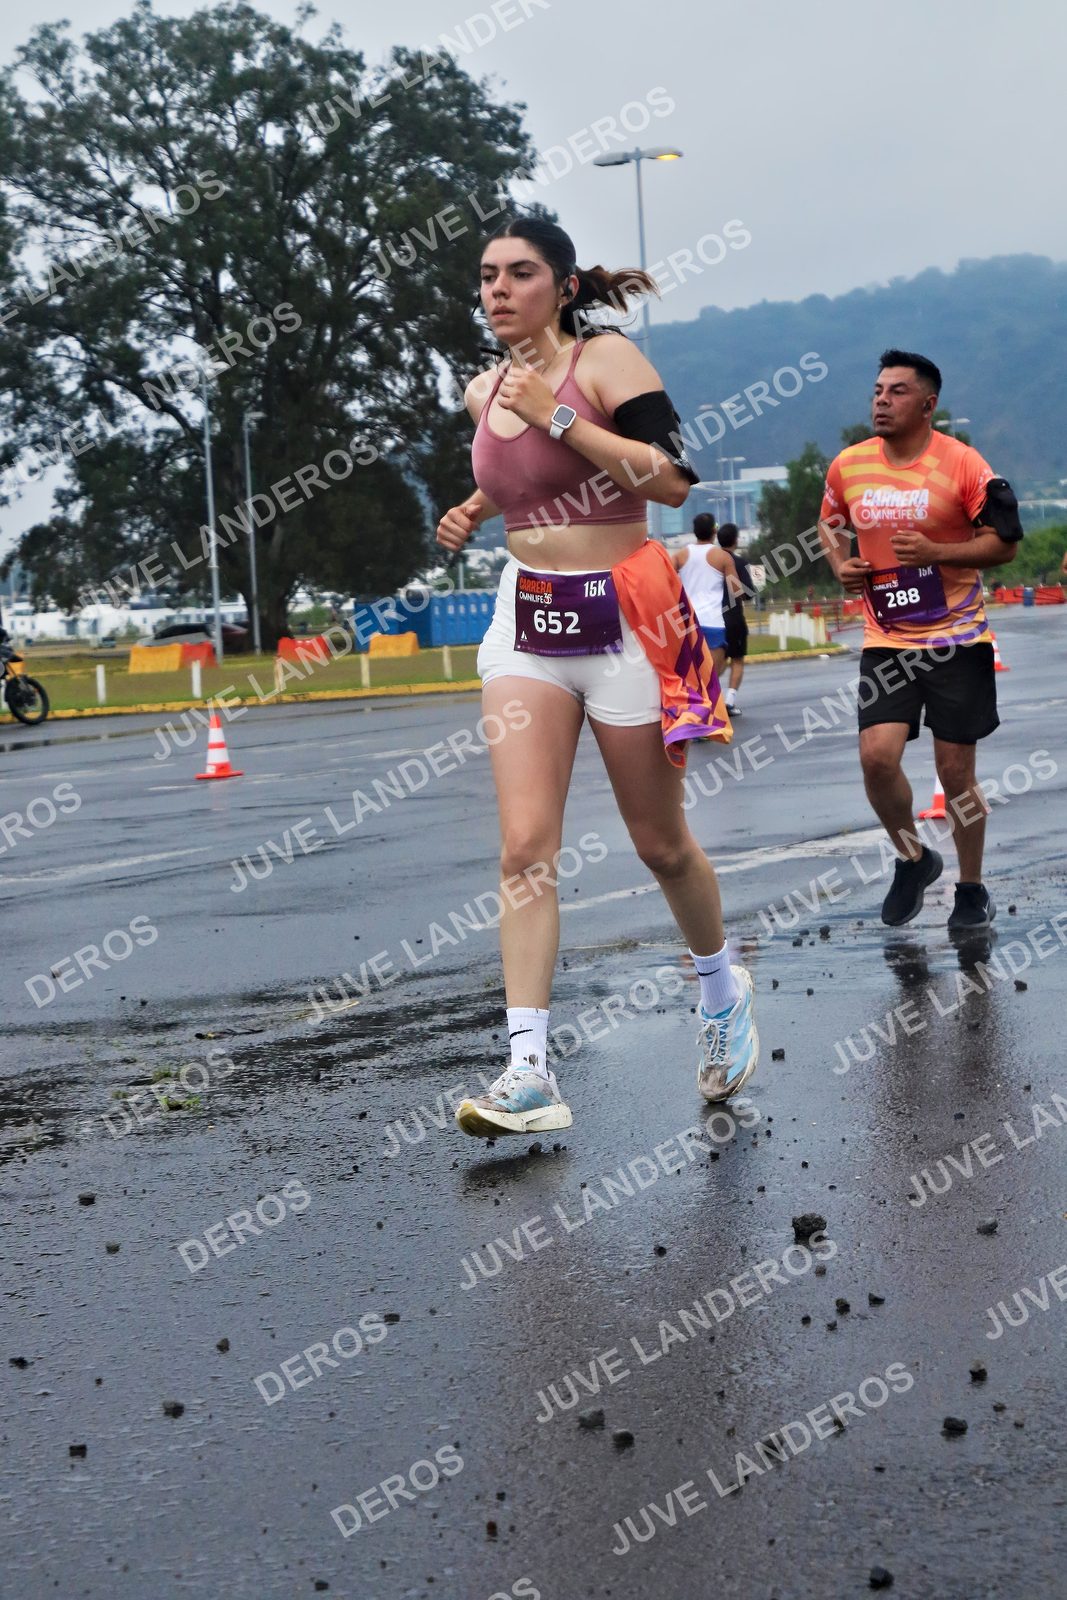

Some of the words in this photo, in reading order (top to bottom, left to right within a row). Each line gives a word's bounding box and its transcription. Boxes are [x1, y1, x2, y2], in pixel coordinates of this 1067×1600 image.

[862, 489, 929, 507] CARRERA
[519, 577, 552, 594] CARRERA
[886, 588, 920, 608] 288
[533, 609, 581, 634] 652
